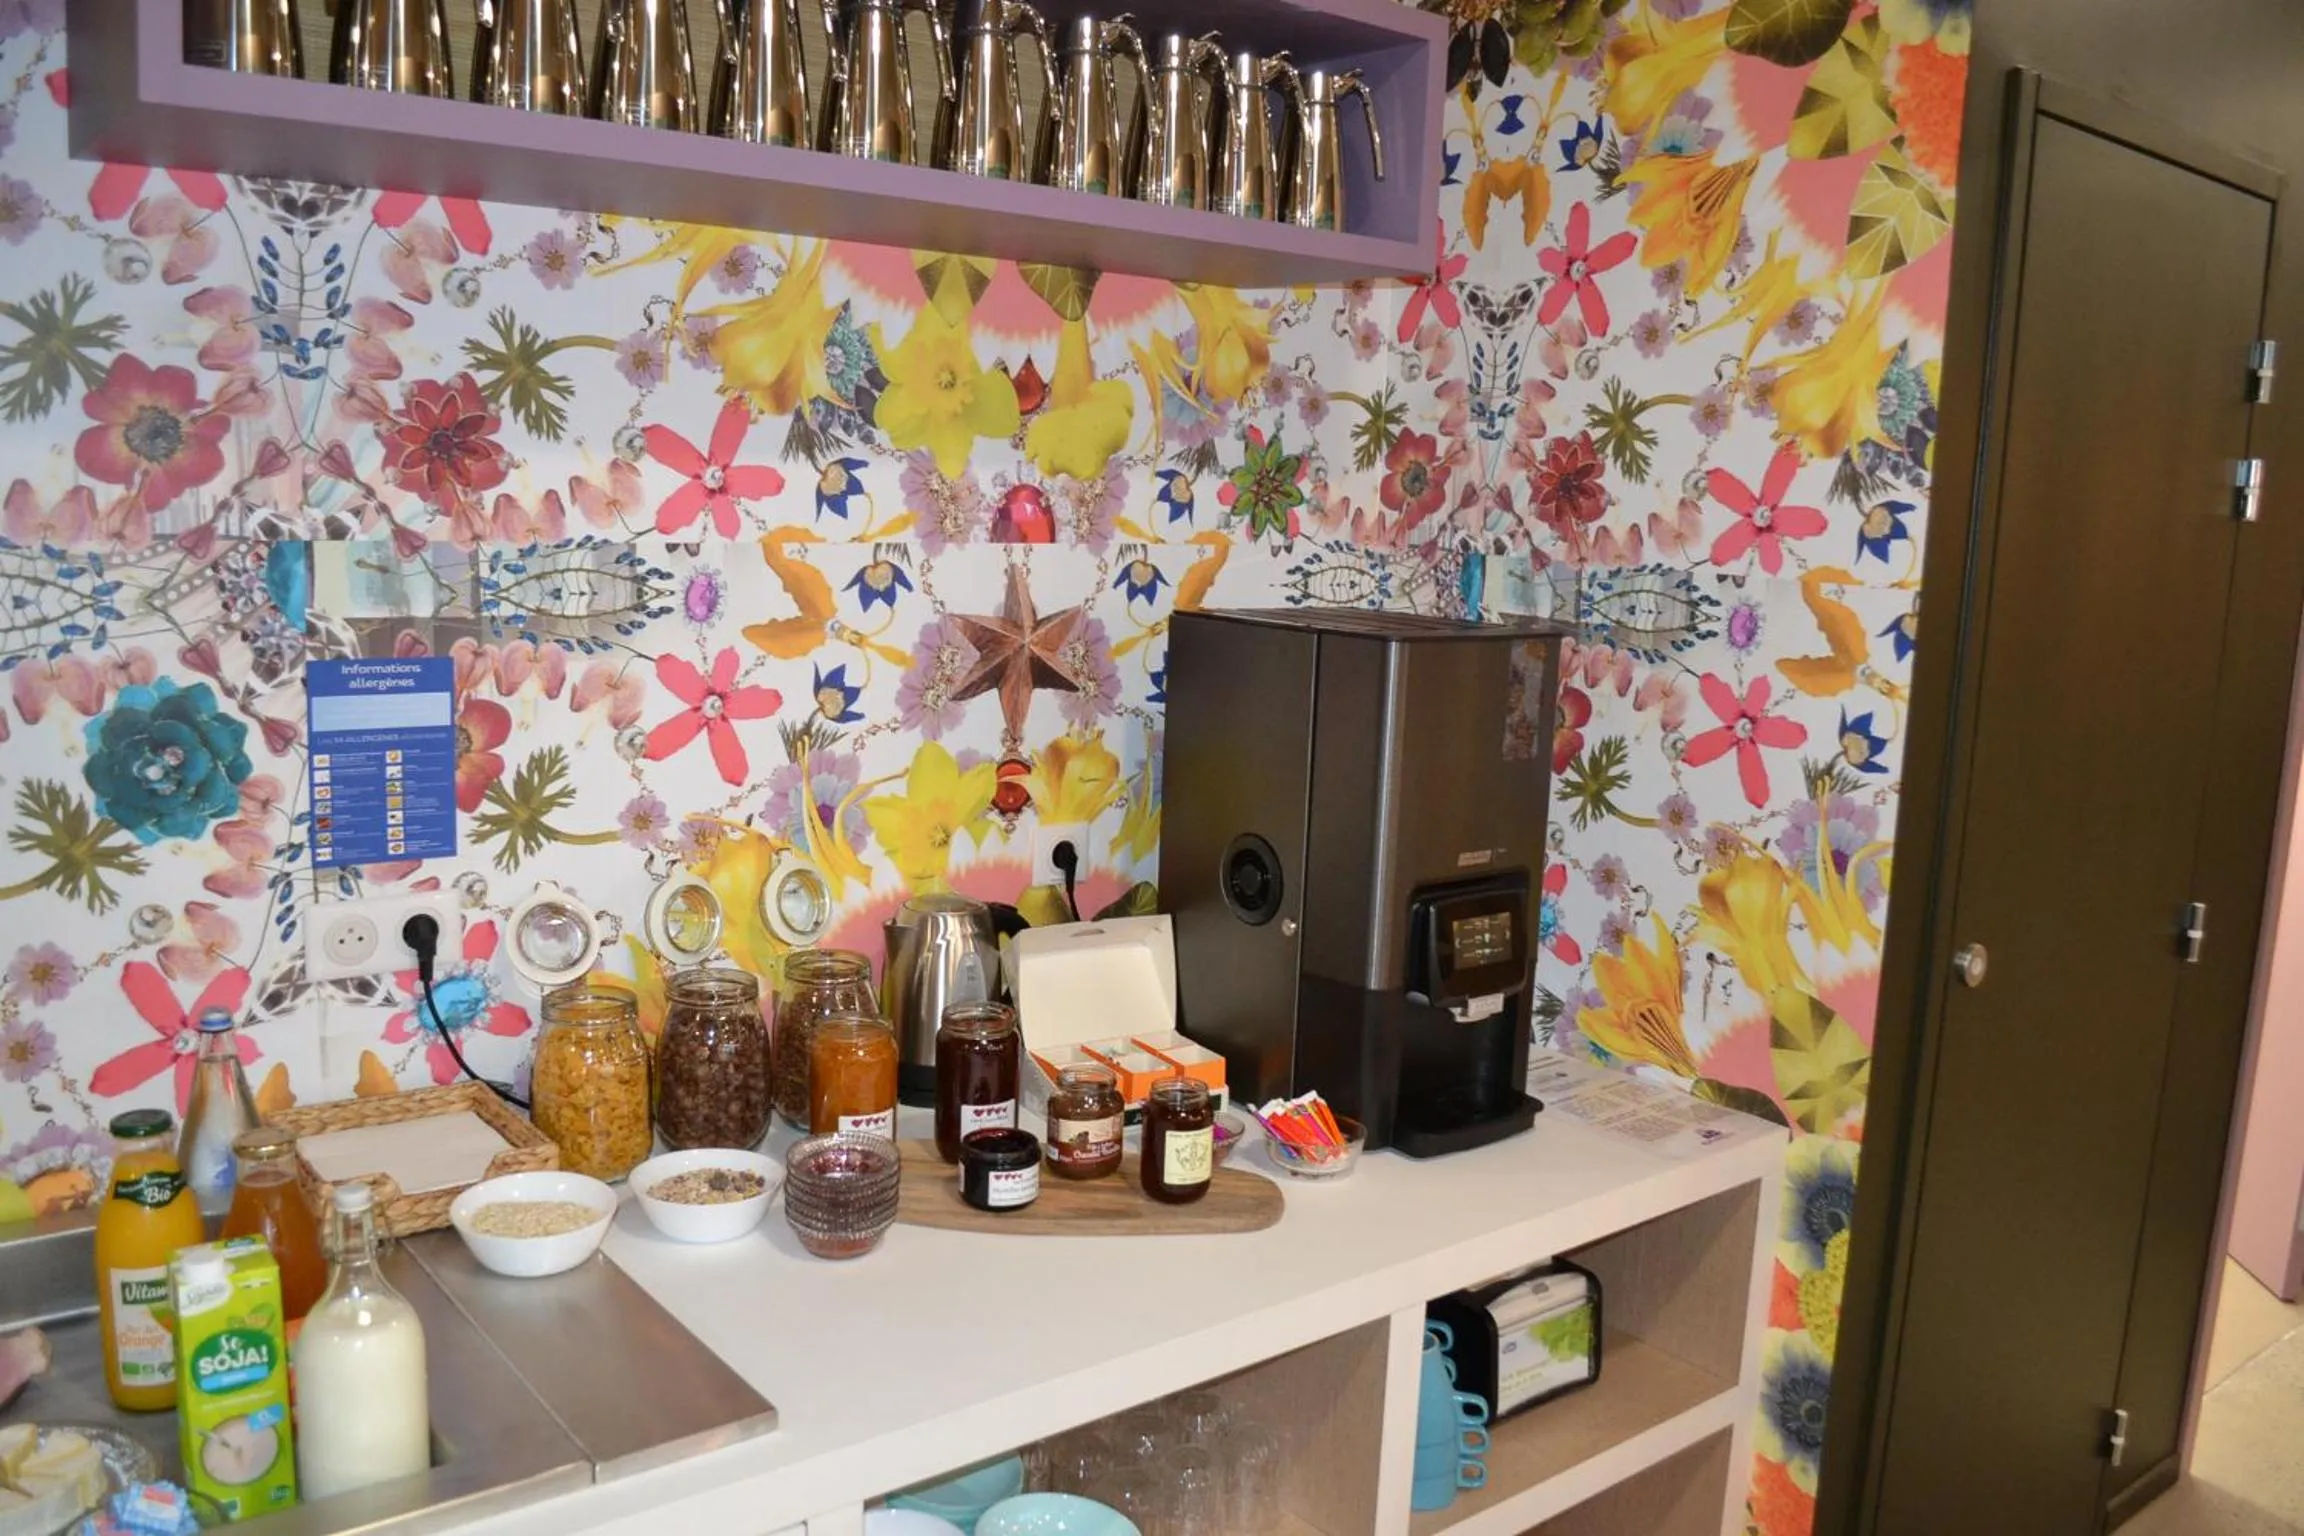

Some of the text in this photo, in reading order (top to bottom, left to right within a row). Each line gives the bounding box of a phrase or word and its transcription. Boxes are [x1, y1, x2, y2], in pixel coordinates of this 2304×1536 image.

[341, 663, 422, 675] Informations
[348, 677, 416, 690] allergènes
[146, 1183, 172, 1203] Bio
[198, 1344, 269, 1376] SOJA!
